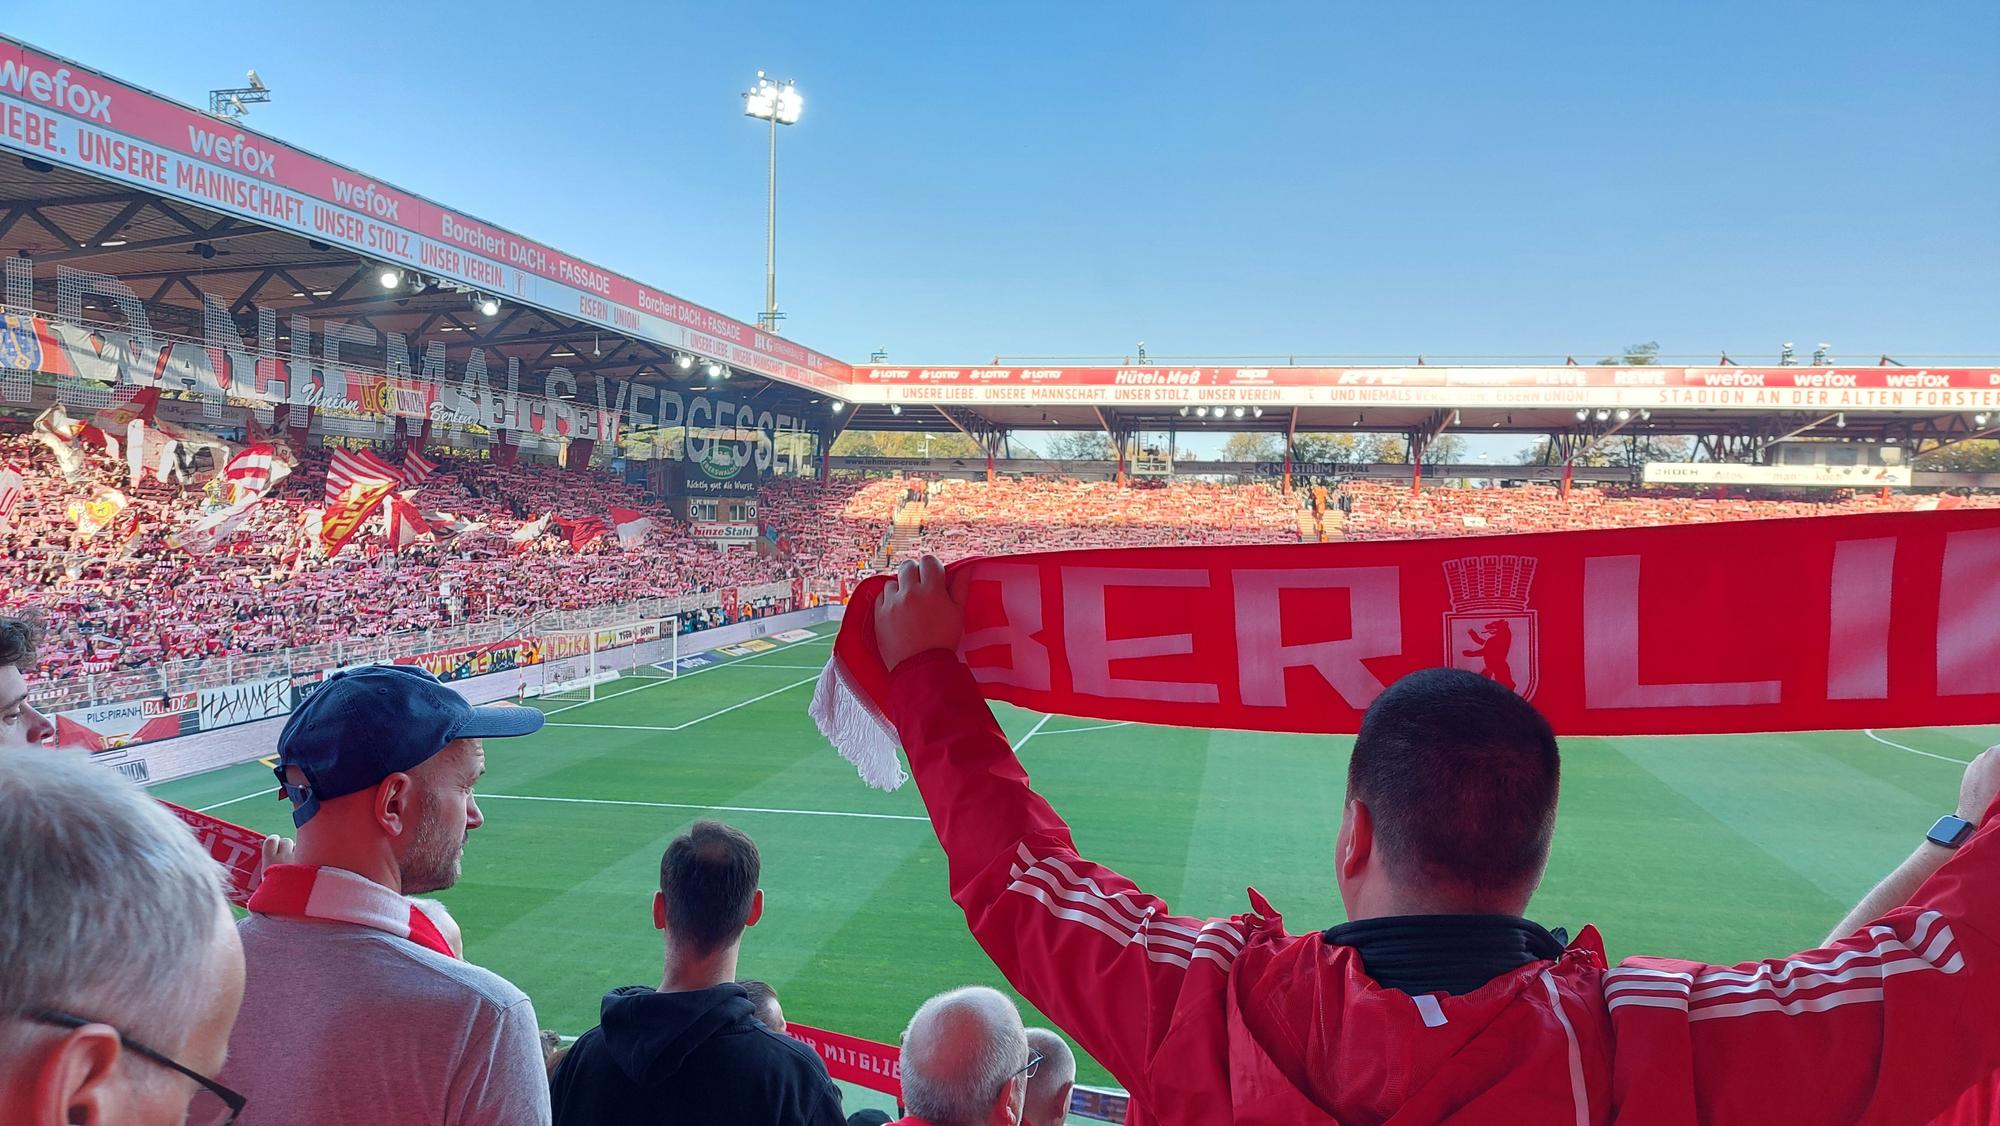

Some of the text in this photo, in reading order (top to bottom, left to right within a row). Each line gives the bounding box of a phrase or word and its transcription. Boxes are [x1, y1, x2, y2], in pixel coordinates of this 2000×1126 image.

[0, 59, 112, 124] wefox
[188, 124, 276, 178] wefox
[332, 177, 399, 221] wefox
[78, 127, 168, 184] UNSERE
[176, 160, 307, 227] MANNSCHAFT.
[314, 205, 364, 245] UNSER
[368, 224, 413, 260] STOLZ.
[420, 240, 460, 275] UNSER
[463, 254, 505, 289] VEREIN.
[441, 213, 506, 259] Borchert
[509, 240, 546, 271] DACH
[559, 260, 610, 295] FASSADE
[579, 295, 640, 331] EISERN UNION!
[638, 289, 677, 319] Borchert
[678, 305, 700, 326] DACH
[708, 314, 741, 341] FASSADE
[880, 370, 910, 379] LOTTO
[930, 371, 960, 379] LOTTO
[981, 370, 1011, 379] LOTTO
[1032, 370, 1062, 379] LOTTO
[1614, 371, 1665, 385] REWE
[1704, 371, 1764, 387] wefox
[1794, 370, 1857, 387] wefox
[1886, 371, 1950, 388] wefox
[301, 383, 359, 412] Union
[902, 387, 942, 399] UNSERE
[946, 388, 977, 399] LIEBE.
[985, 388, 1026, 399] UNSERE
[1032, 388, 1107, 400] MANNSCHAFT.
[1115, 389, 1151, 400] UNSER
[1155, 389, 1192, 400] STOLZ.
[1199, 389, 1235, 400] UNSER
[1331, 390, 1355, 401] UND
[1359, 390, 1412, 401] NIEMALS
[1659, 390, 1744, 403] STADION
[1756, 390, 1780, 403] AN
[1793, 390, 1828, 404] DER
[1840, 391, 1903, 404] ALTEN
[430, 400, 475, 424] Berlin
[691, 505, 698, 516] 0
[750, 507, 756, 517] 0
[201, 678, 292, 729] HAMMER
